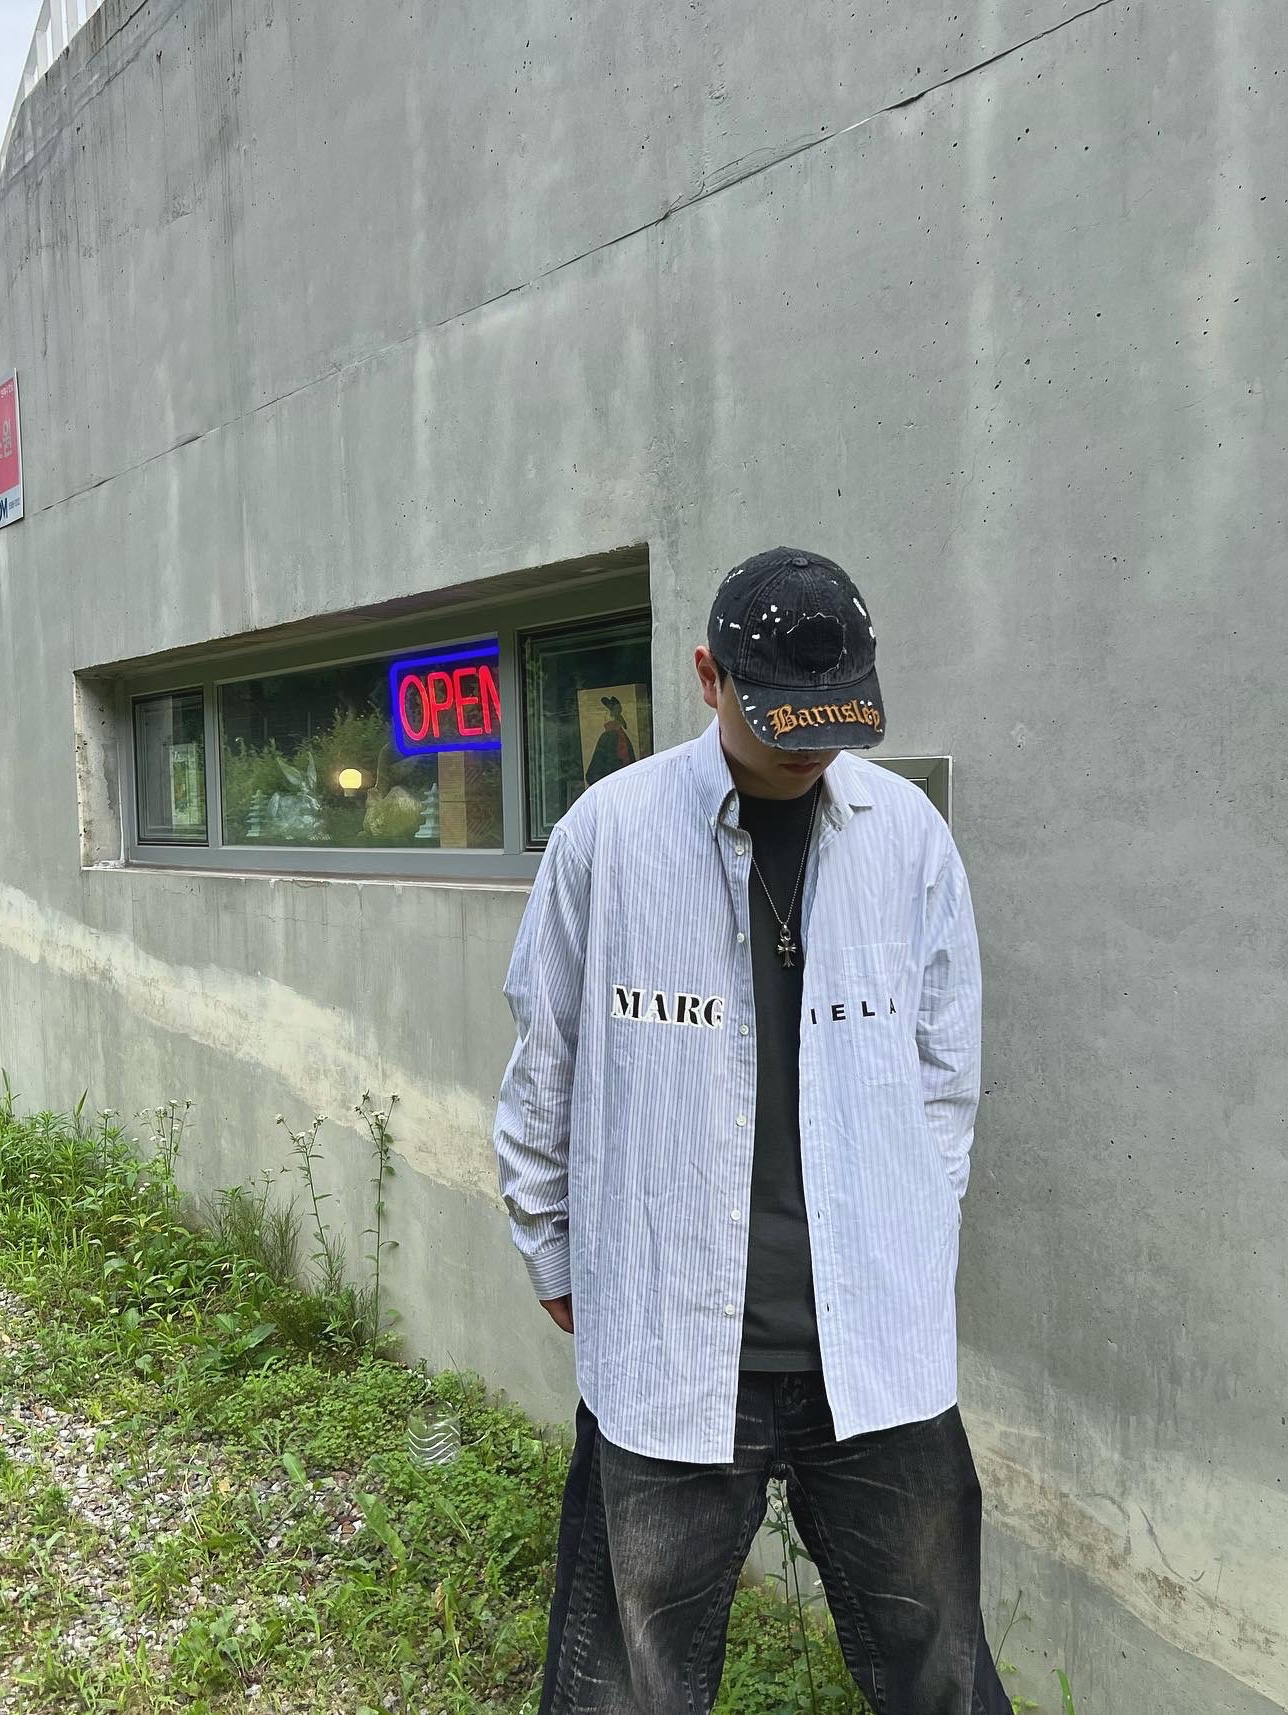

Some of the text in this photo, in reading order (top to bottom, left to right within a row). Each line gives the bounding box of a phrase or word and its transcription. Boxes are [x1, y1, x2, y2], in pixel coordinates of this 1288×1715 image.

[399, 665, 501, 740] OPEN
[766, 700, 882, 740] Barnsley
[611, 985, 724, 1030] MARG
